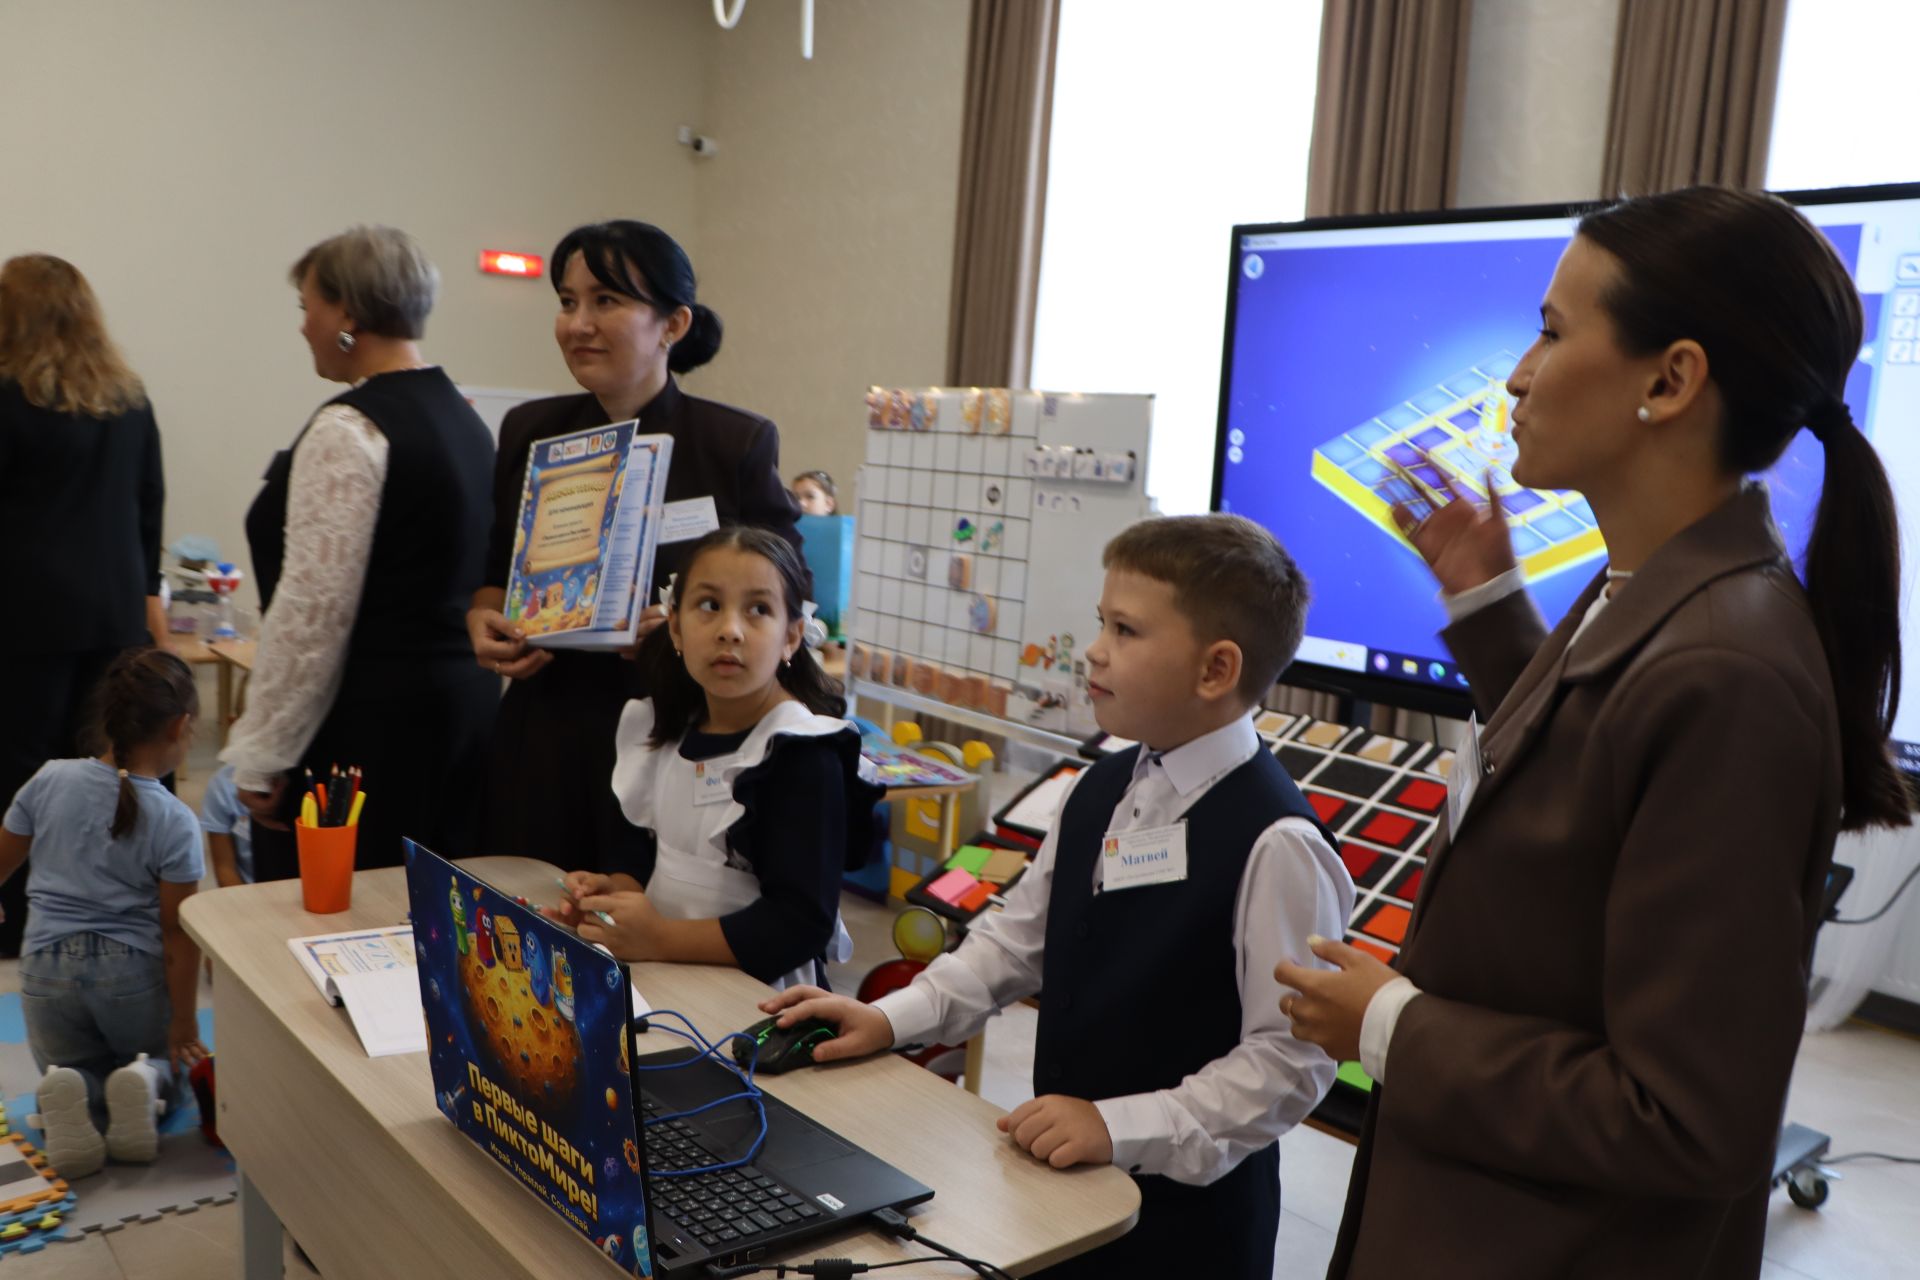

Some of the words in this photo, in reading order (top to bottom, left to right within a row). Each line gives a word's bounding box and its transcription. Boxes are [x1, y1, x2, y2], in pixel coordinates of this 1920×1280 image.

[1121, 848, 1169, 867] Матвей
[468, 1061, 538, 1135] Первые
[541, 1120, 594, 1185] шаги
[472, 1100, 484, 1123] в
[484, 1102, 598, 1221] ПиктоМире!
[551, 1193, 591, 1235] Создавай.
